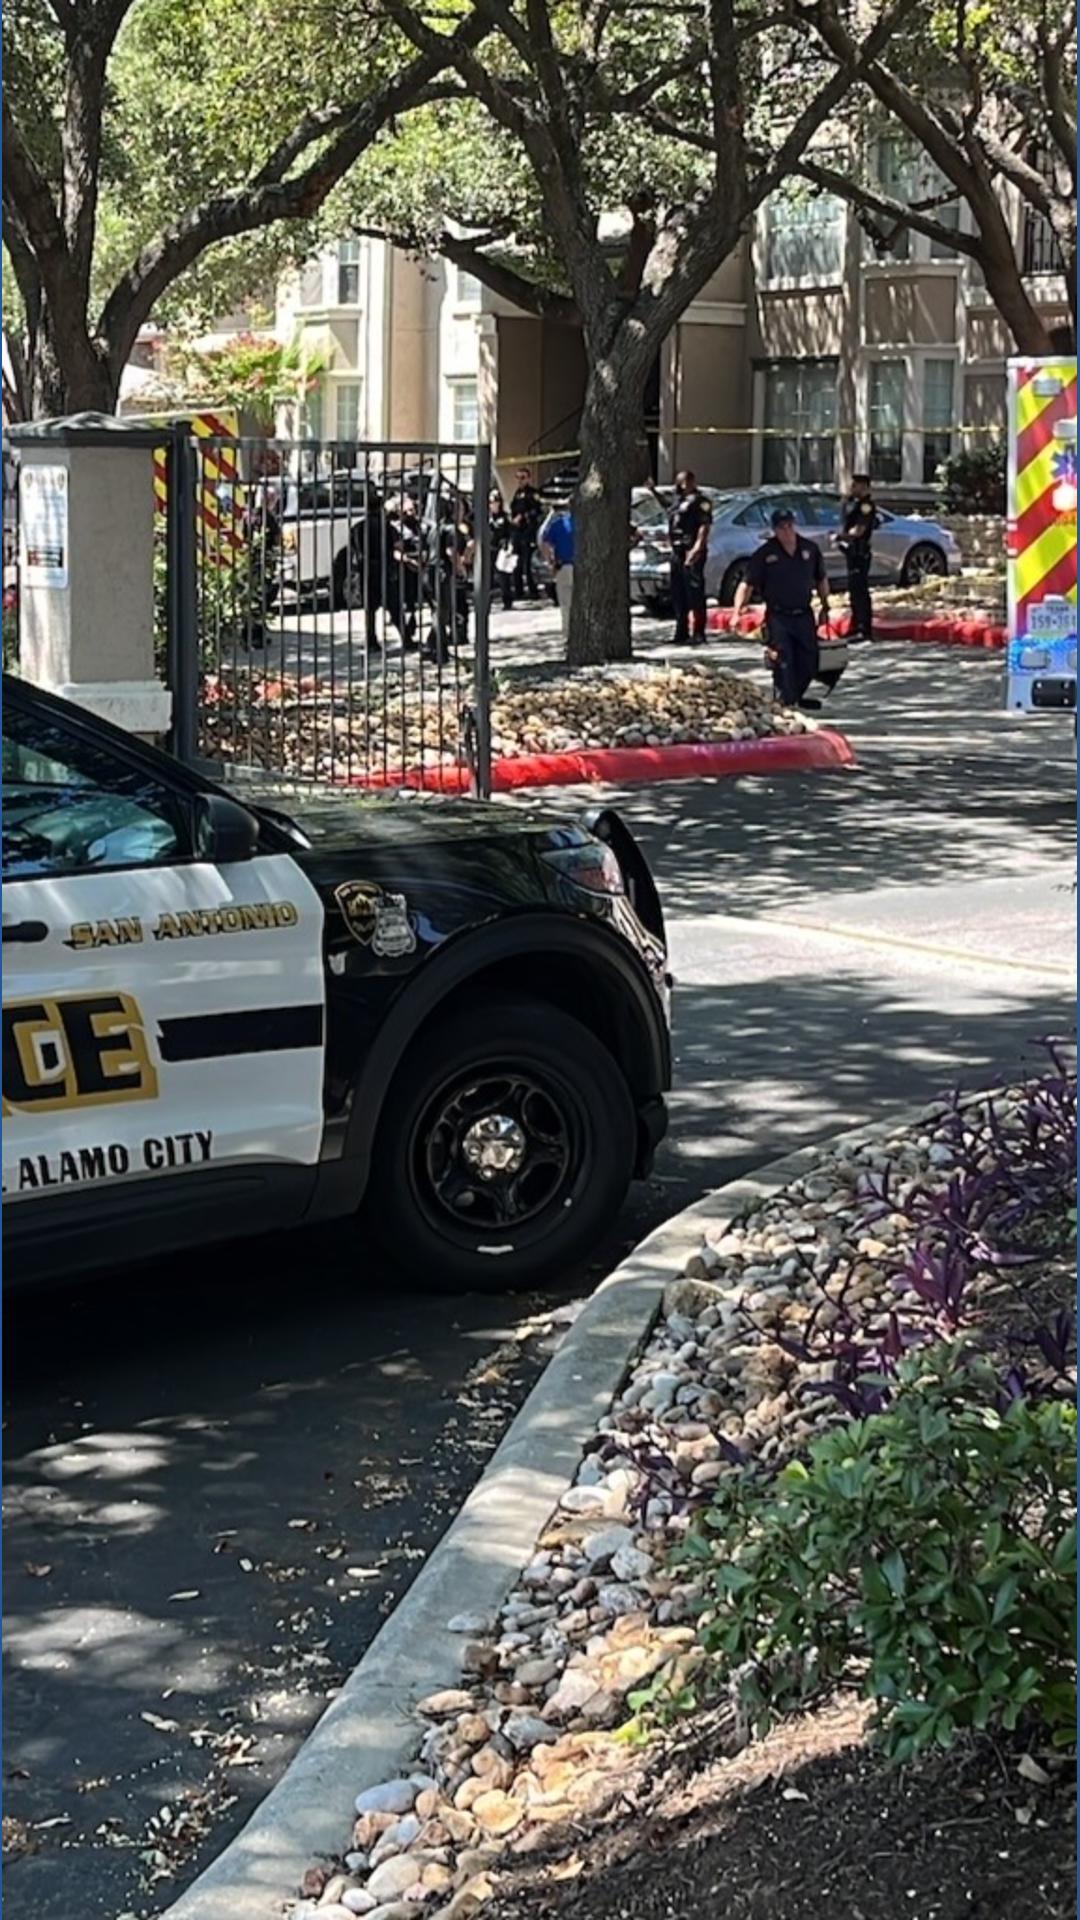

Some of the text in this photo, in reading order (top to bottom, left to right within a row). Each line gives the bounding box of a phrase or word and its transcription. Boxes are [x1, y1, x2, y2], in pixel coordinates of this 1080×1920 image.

[65, 901, 299, 950] SAN ANTONIO
[18, 1130, 213, 1190] ALAMO CITY
